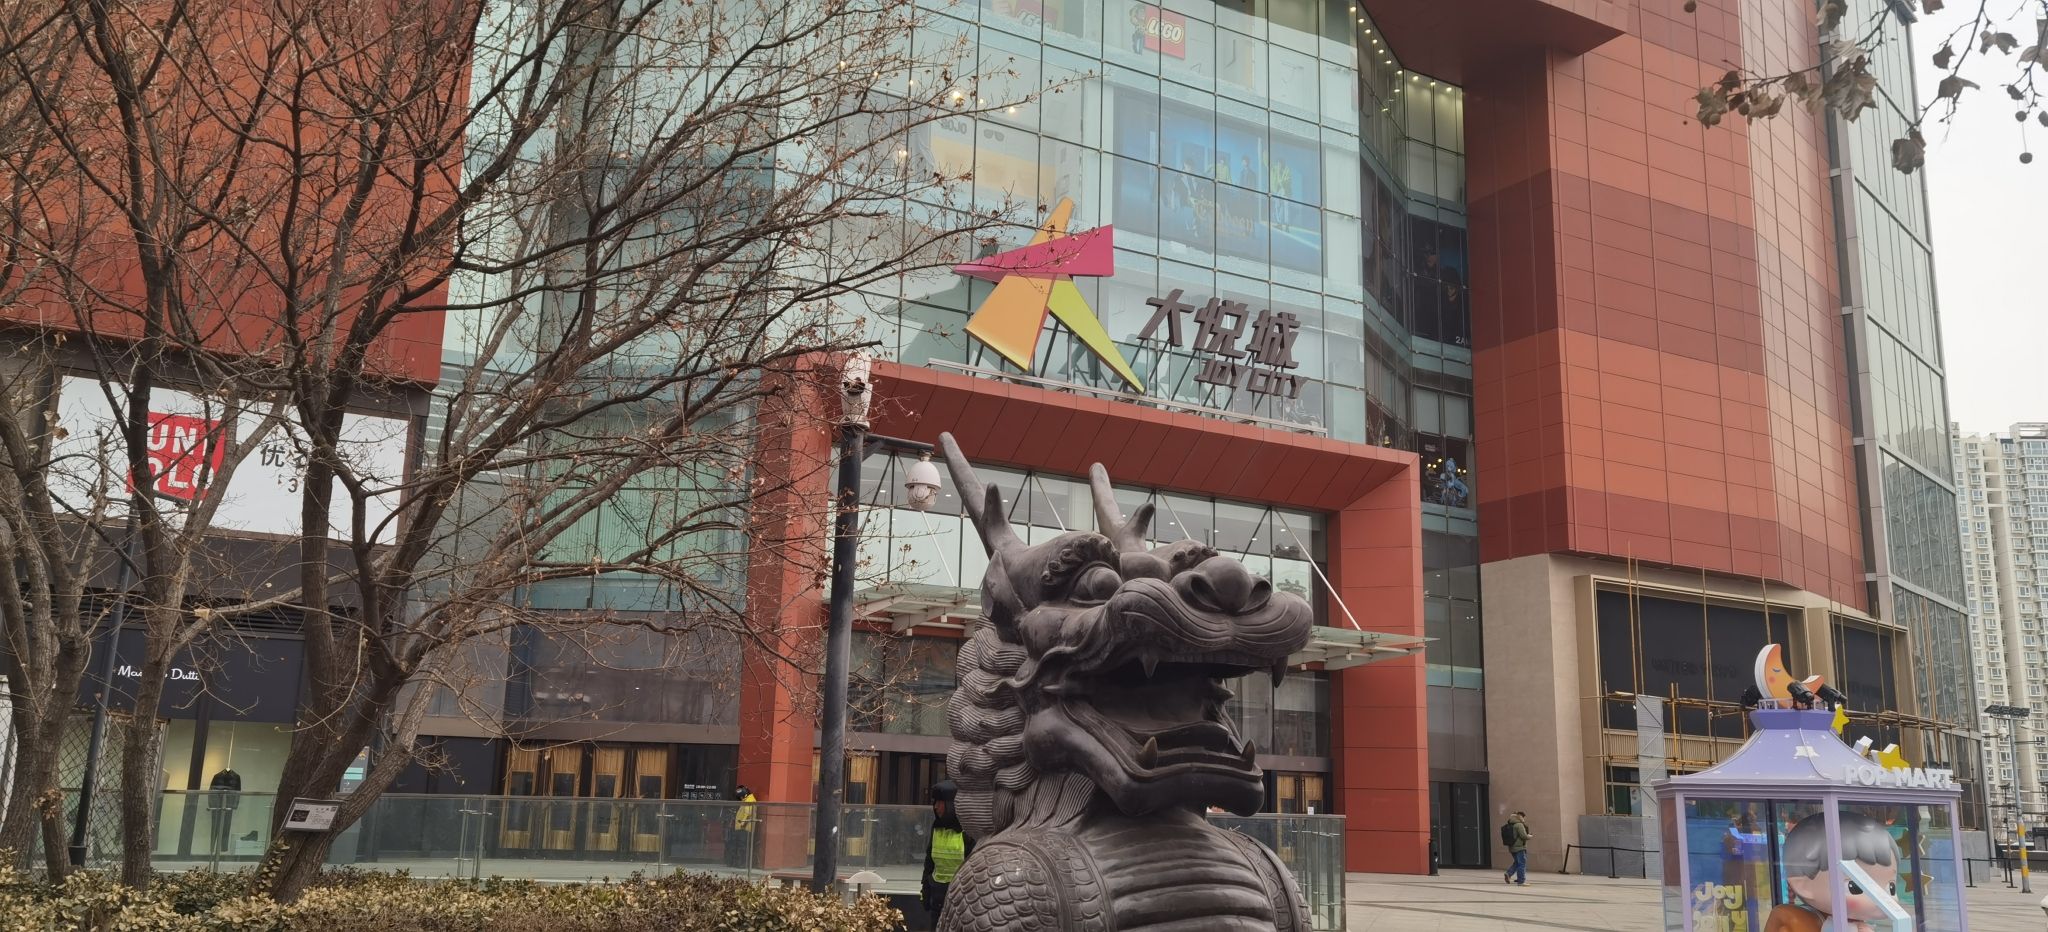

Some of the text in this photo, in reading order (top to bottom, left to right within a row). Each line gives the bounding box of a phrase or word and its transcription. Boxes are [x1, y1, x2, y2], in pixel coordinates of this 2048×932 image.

[1147, 18, 1183, 44] LEGO
[1137, 289, 1301, 369] 大悦城
[1194, 359, 1309, 399] JOY CITY
[170, 667, 200, 681] Dutti
[1845, 765, 1954, 789] POP MART
